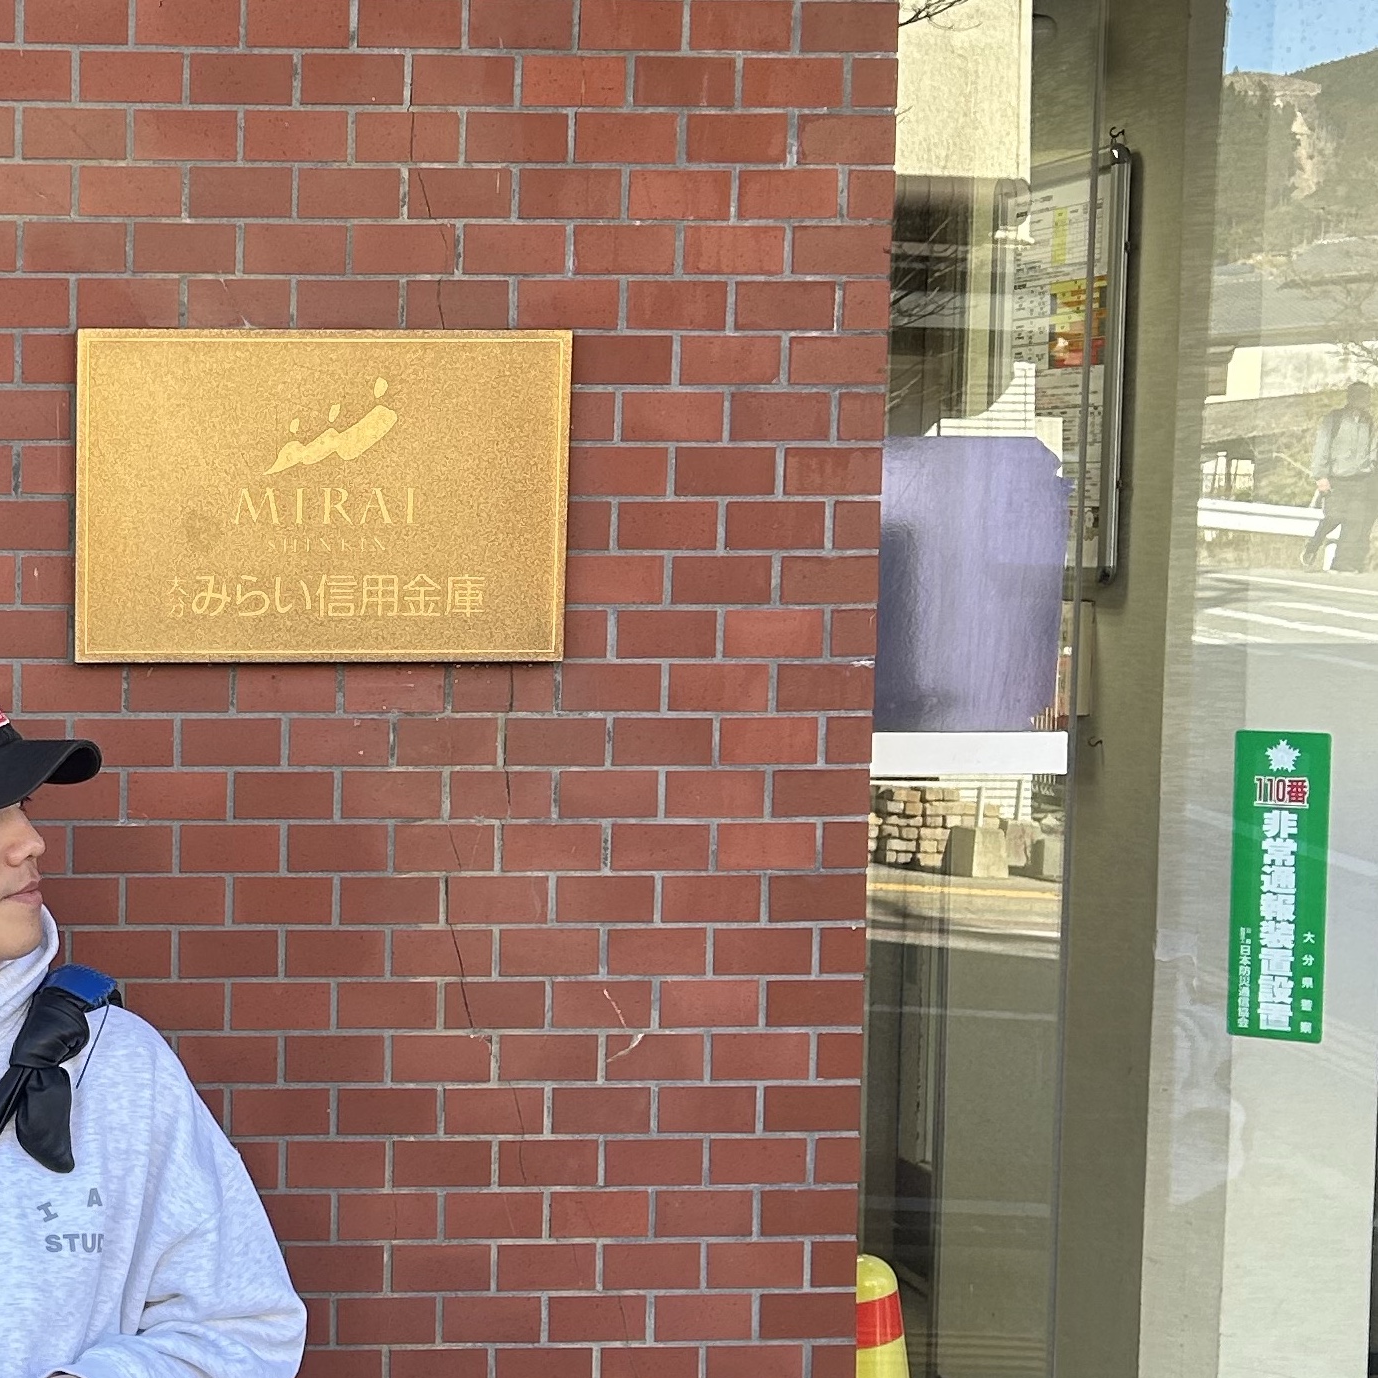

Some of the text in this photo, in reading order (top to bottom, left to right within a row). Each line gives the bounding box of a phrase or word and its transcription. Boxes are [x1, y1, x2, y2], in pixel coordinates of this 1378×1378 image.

[233, 486, 421, 526] MIRAI
[1254, 776, 1309, 805] 110番
[1257, 810, 1298, 1031] 非常通報装置設置
[36, 1201, 59, 1223] I
